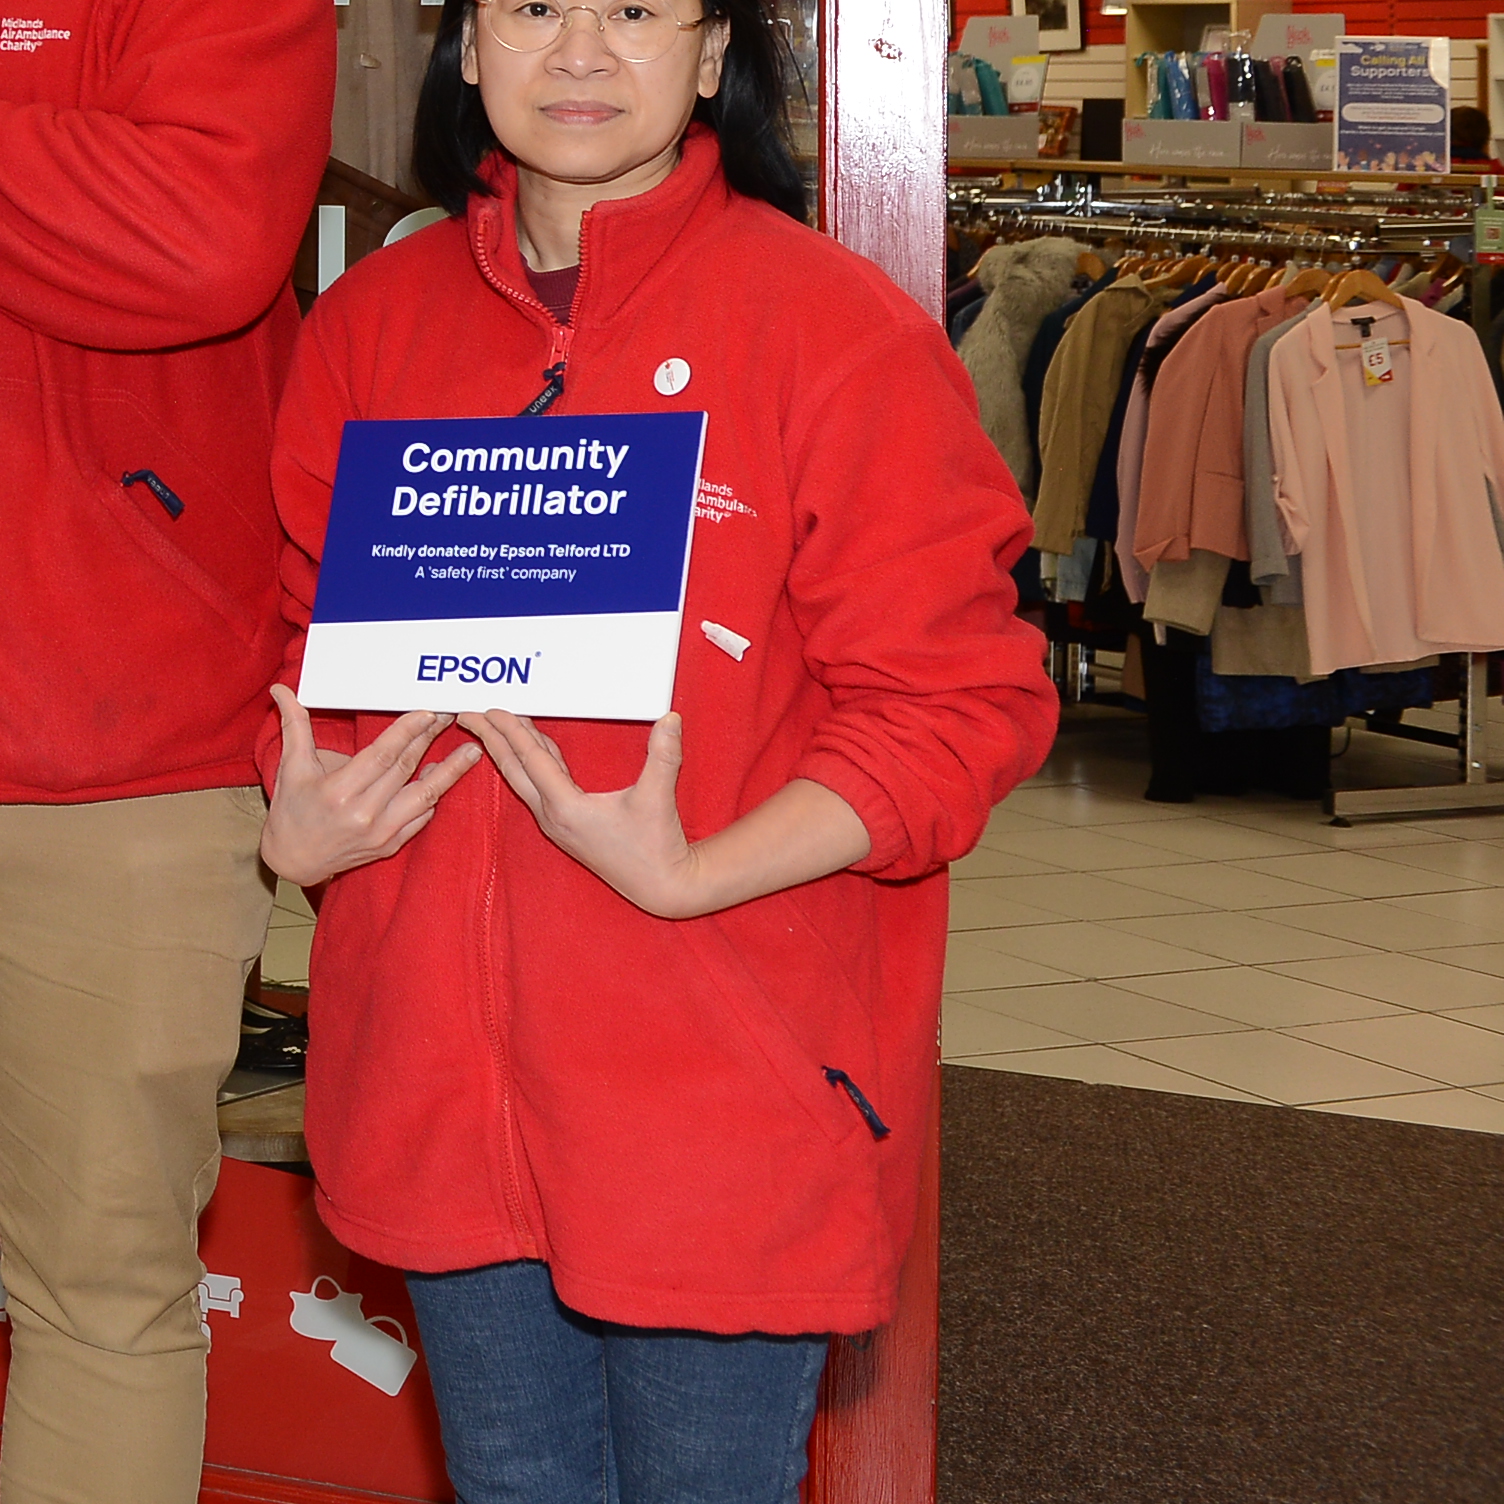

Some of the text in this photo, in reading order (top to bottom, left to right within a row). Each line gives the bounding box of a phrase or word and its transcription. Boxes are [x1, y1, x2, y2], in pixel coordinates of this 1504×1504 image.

[1, 18, 44, 29] Midlands
[1360, 55, 1426, 68] Calling All
[1350, 65, 1430, 79] Supporters
[528, 385, 558, 413] uneek
[402, 438, 630, 479] Community
[391, 483, 627, 517] Defibrillator
[371, 543, 631, 560] Kindly donated by Epson Telford LTD
[414, 565, 577, 583] A 'safety first' company
